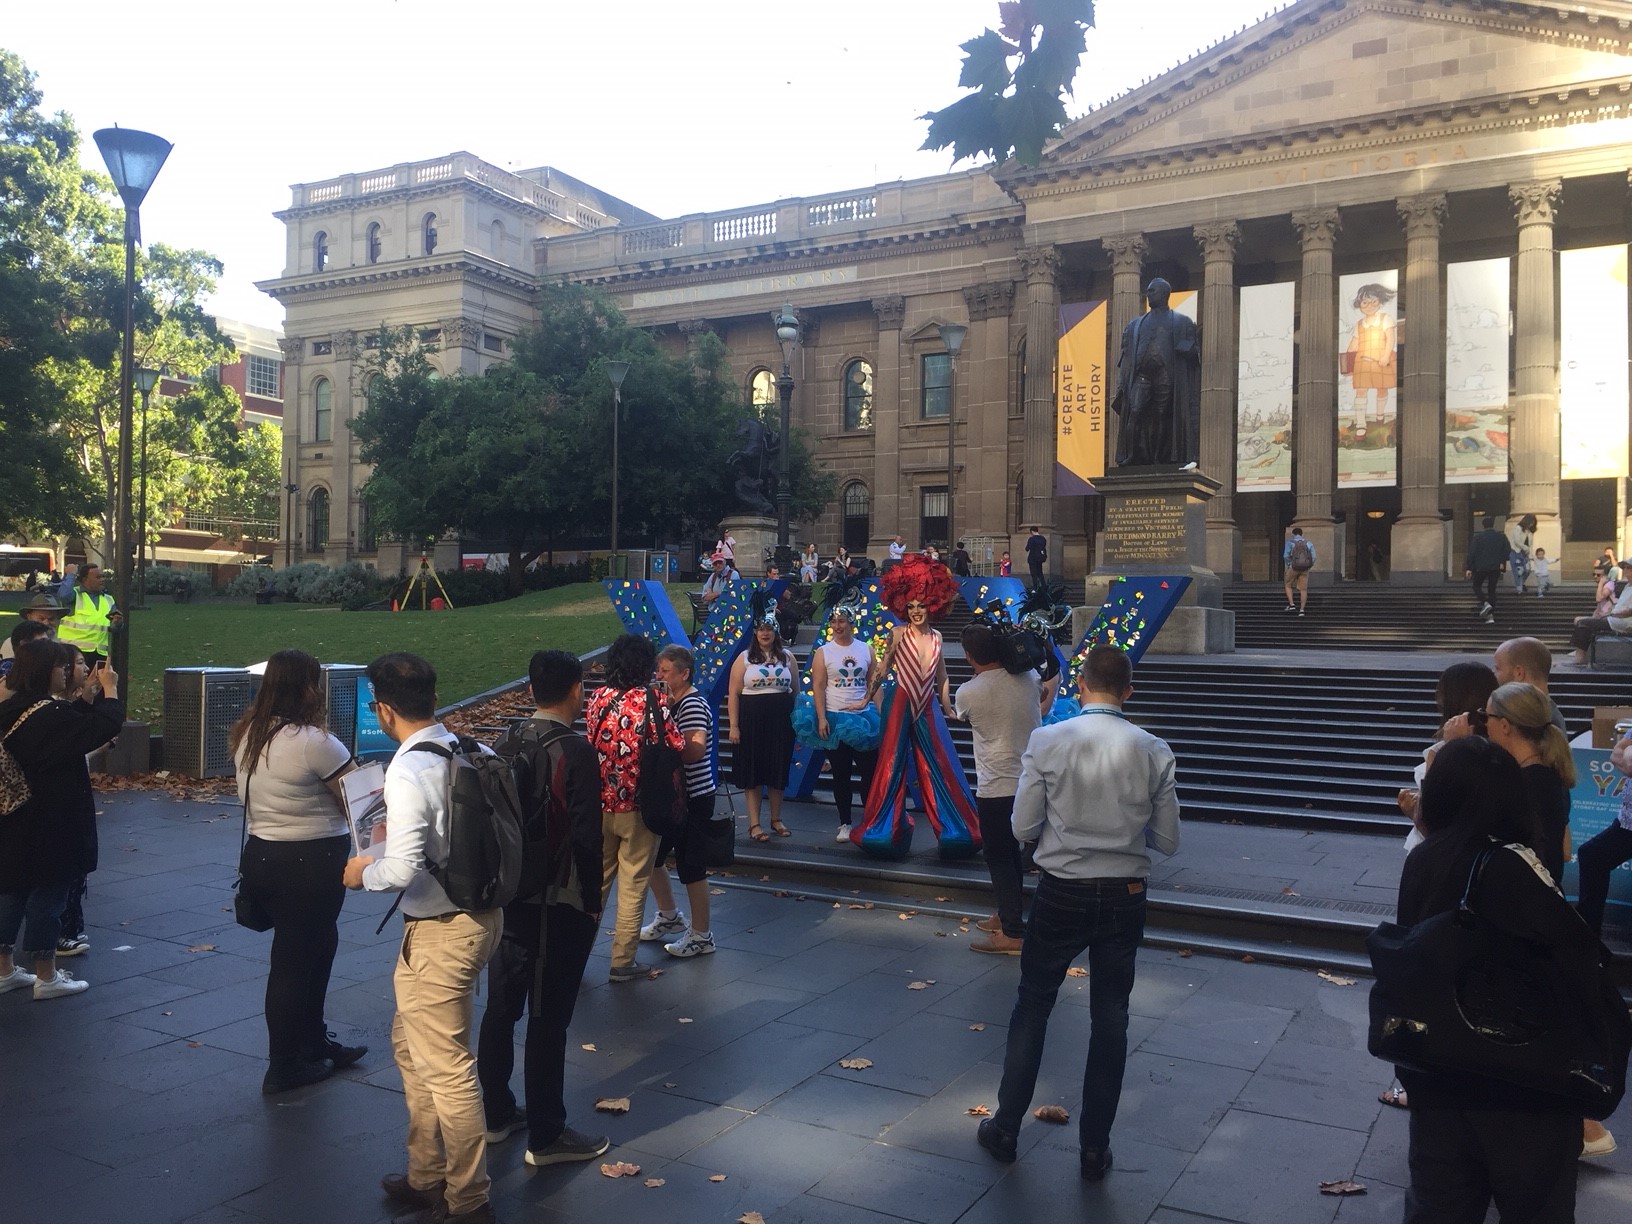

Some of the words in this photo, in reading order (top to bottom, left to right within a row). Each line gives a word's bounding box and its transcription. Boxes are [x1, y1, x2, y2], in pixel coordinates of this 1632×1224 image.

[1272, 144, 1468, 184] VICTORIA
[745, 269, 849, 294] LIBRARY
[1062, 363, 1073, 436] #CREATE
[1076, 383, 1087, 414] ART
[1090, 363, 1101, 432] HISTORY
[1125, 498, 1166, 506] ERECTED
[1118, 532, 1152, 540] REDMOND
[1152, 531, 1177, 539] BARRY
[1589, 760, 1615, 773] SO
